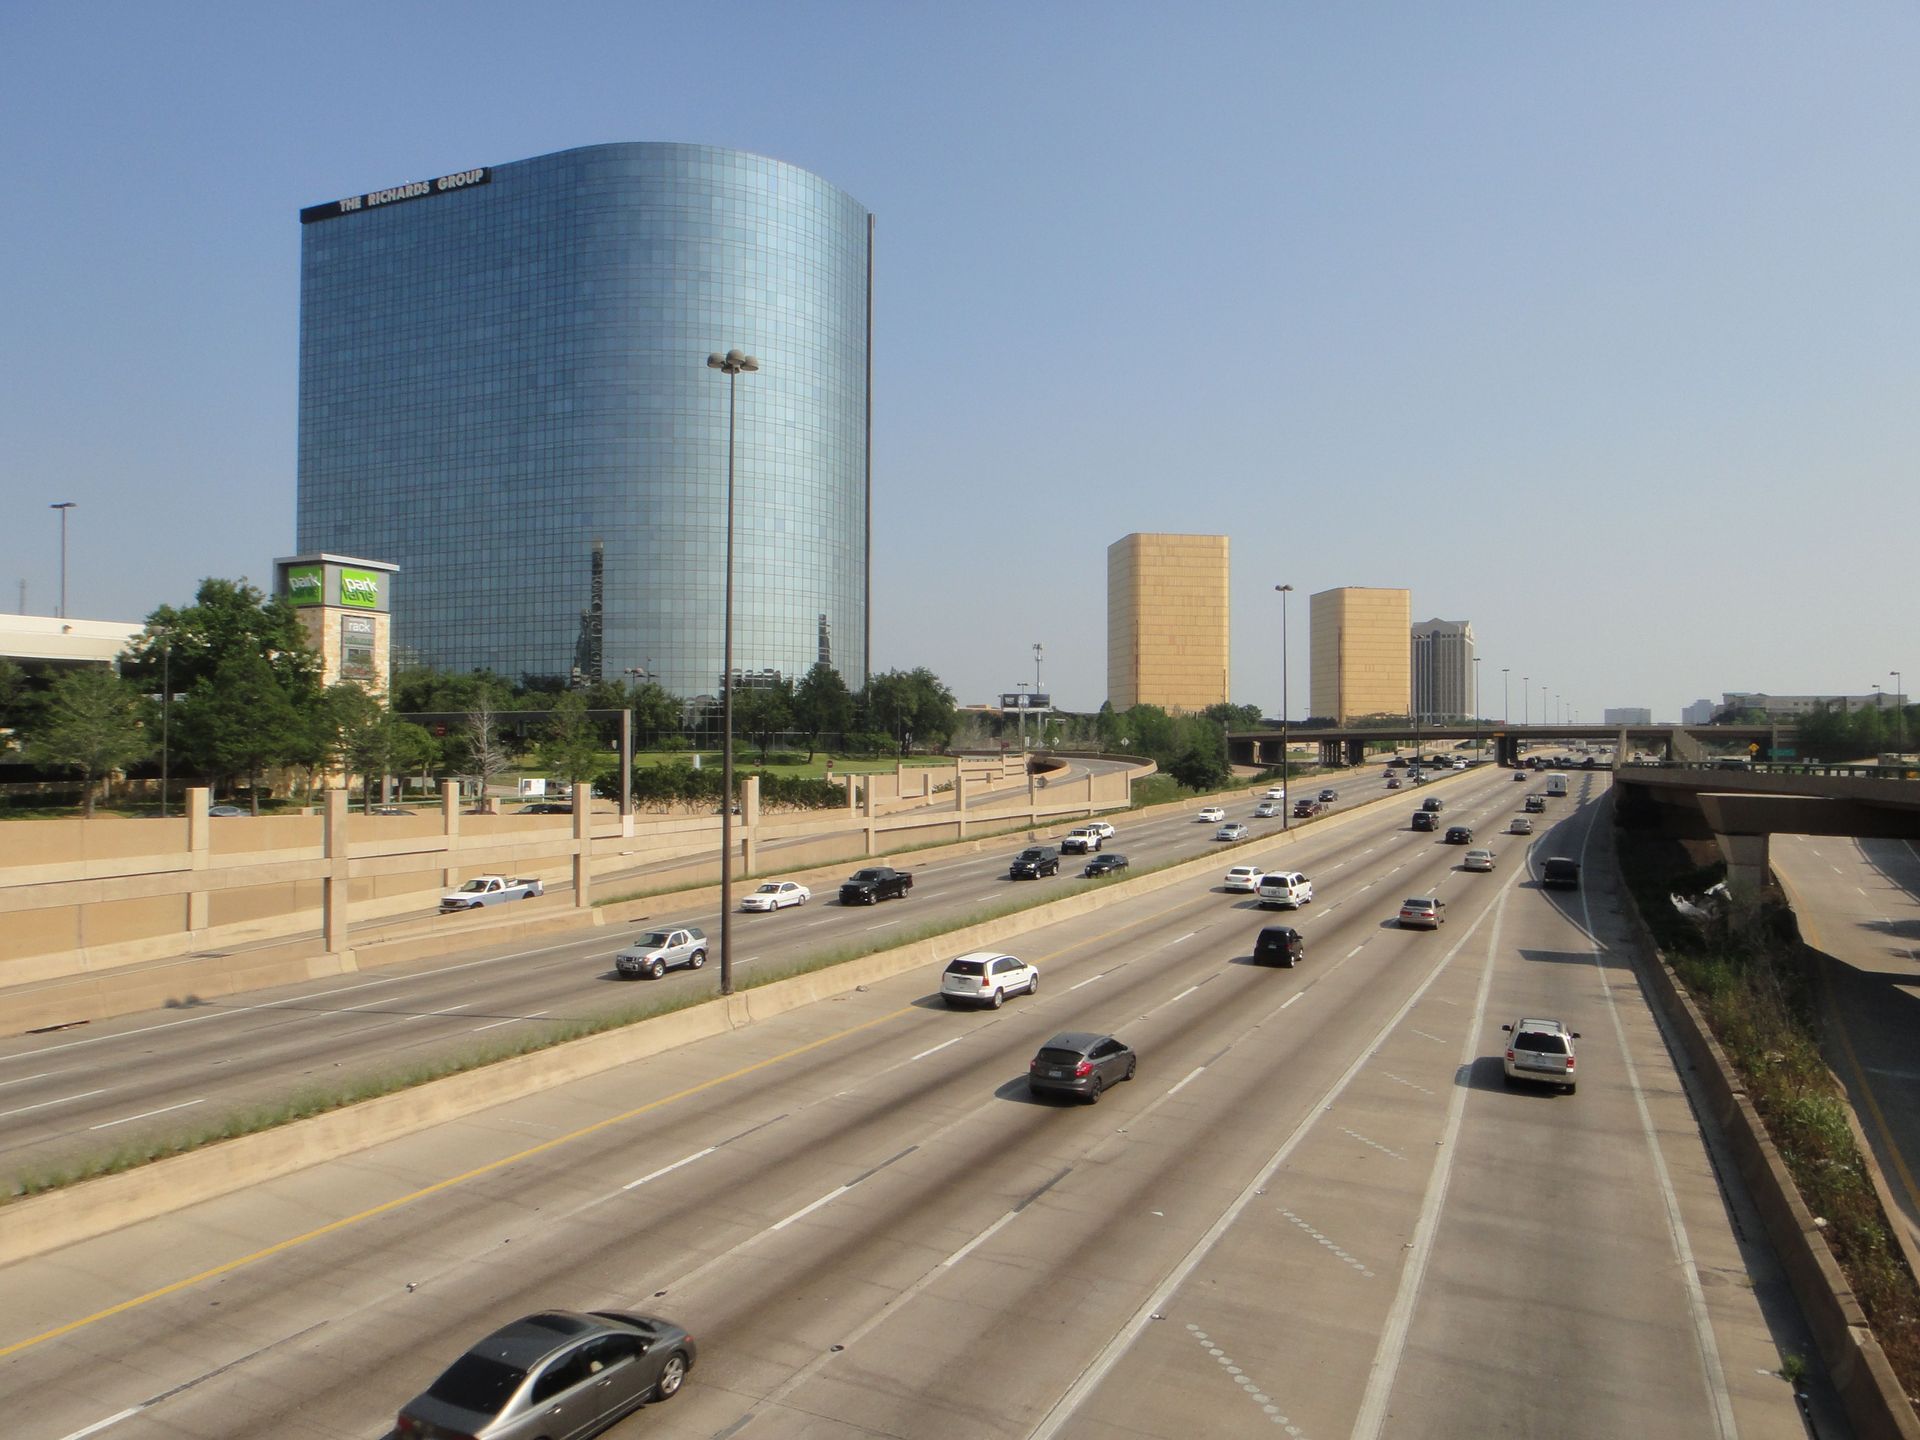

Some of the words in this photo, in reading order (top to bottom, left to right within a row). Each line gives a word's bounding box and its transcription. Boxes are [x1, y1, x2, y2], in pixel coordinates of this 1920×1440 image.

[339, 197, 362, 212] THE
[367, 182, 430, 206] RICHARDS
[438, 169, 484, 190] GROUP
[289, 573, 321, 592] park
[344, 577, 378, 592] park
[348, 619, 371, 632] rack
